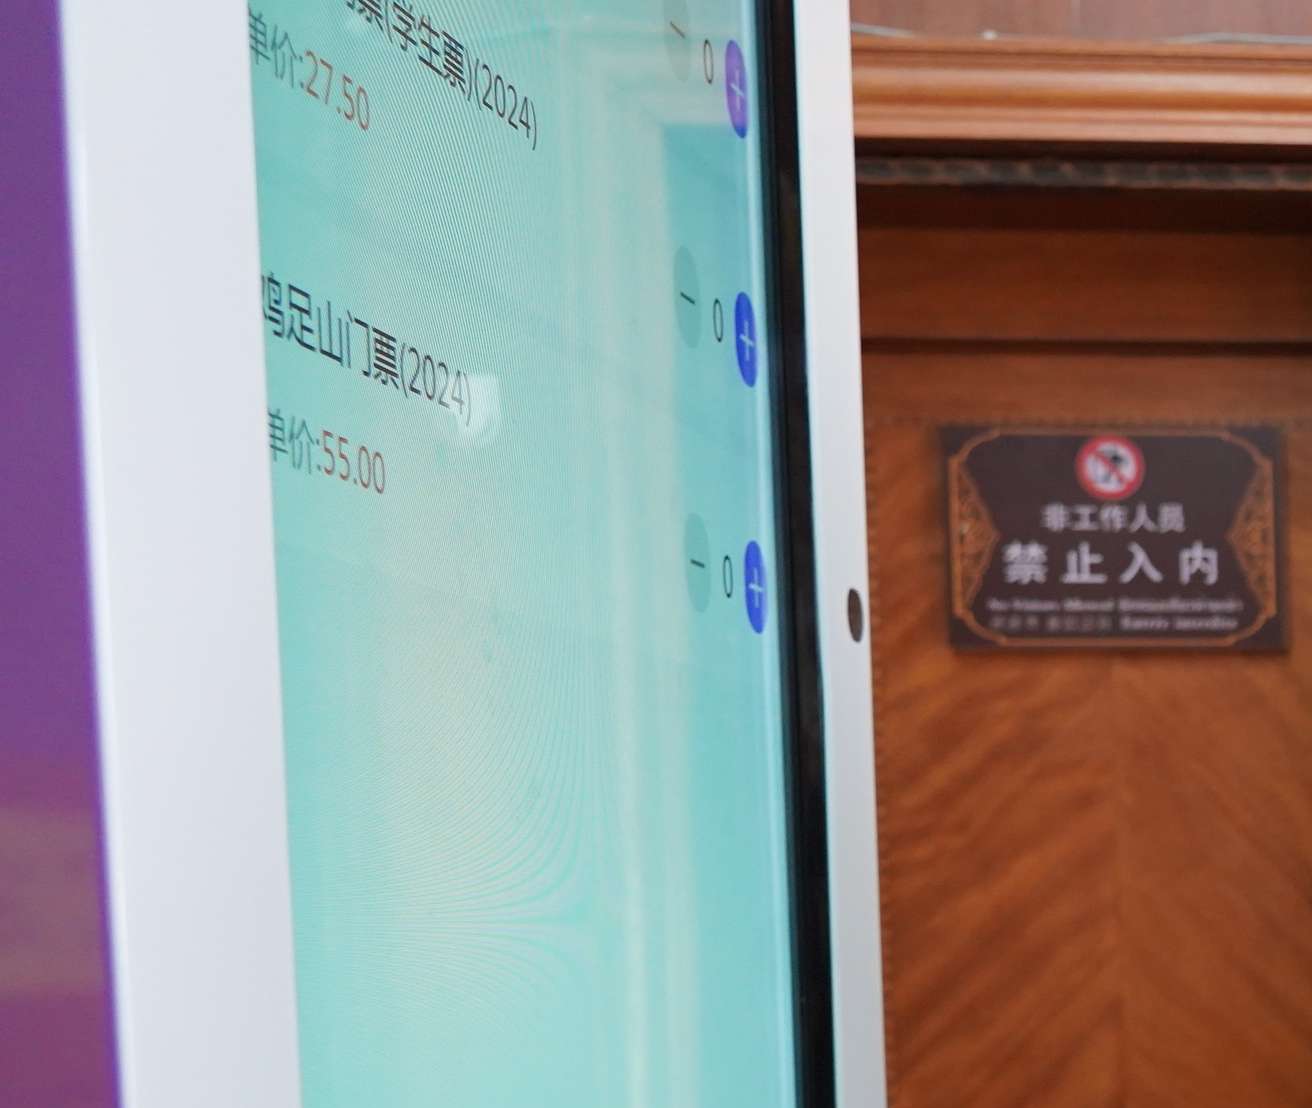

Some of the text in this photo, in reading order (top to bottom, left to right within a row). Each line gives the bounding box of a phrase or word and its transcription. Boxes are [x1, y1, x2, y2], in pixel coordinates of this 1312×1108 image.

[713, 298, 723, 343] 0
[267, 408, 386, 494] 单价:55.00
[1041, 503, 1185, 533] 非工作人员
[722, 555, 733, 598] 0
[1003, 541, 1219, 584] 禁止入内
